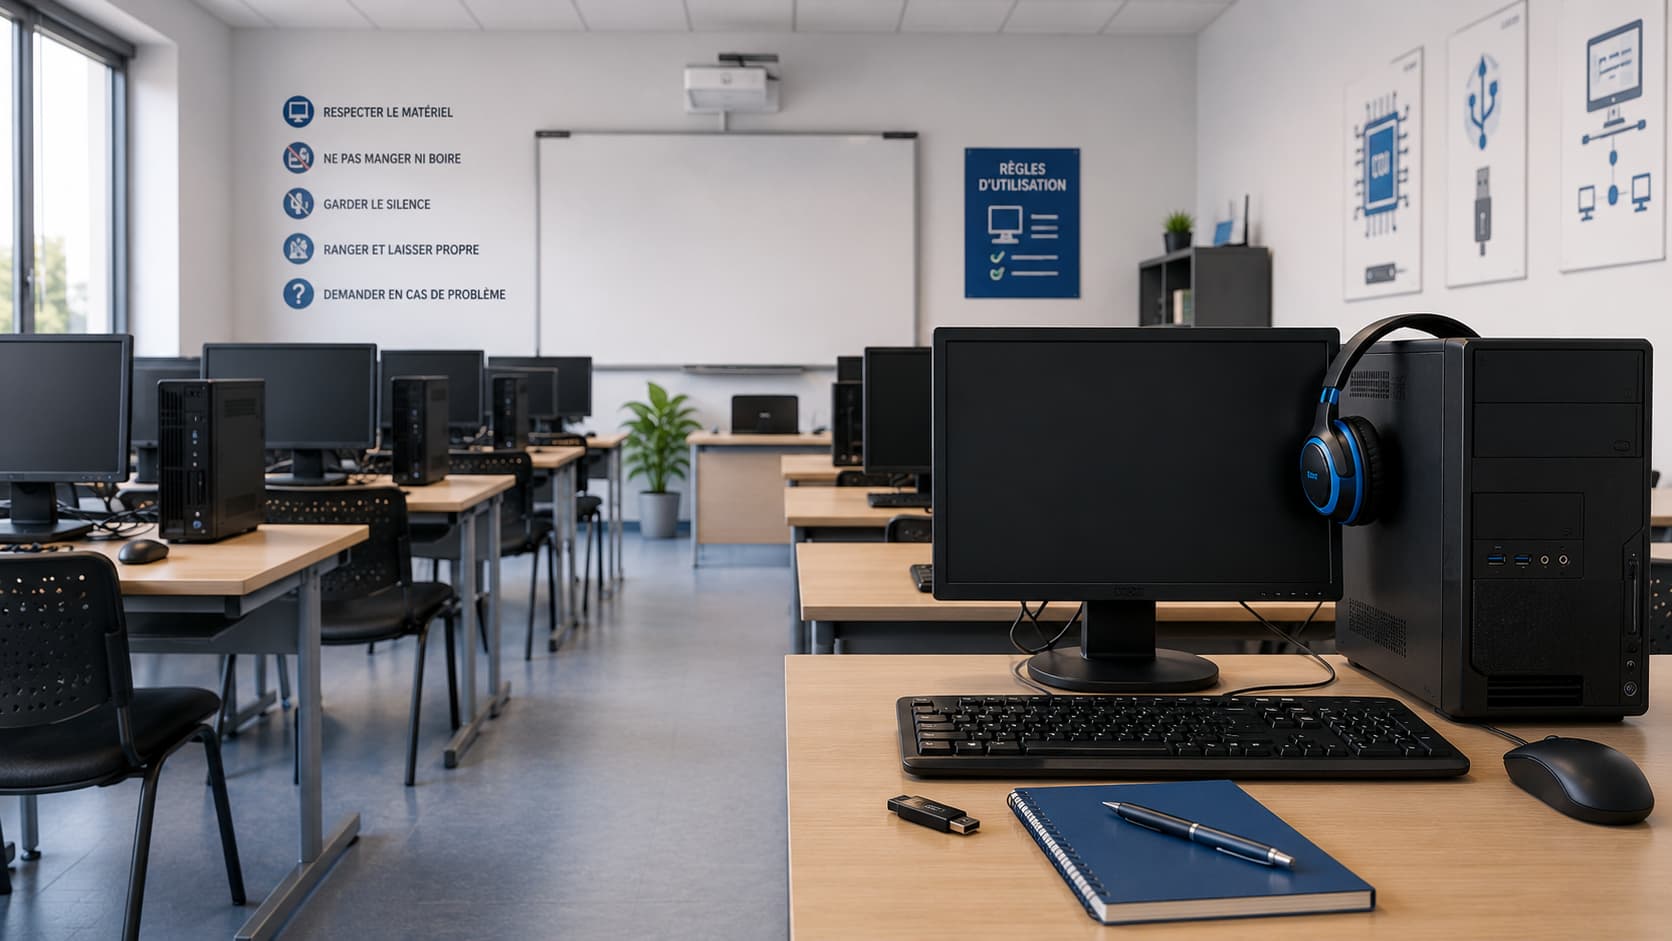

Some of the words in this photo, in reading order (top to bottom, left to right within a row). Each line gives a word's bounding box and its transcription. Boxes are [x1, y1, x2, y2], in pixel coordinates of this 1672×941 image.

[323, 107, 384, 118] RESPECTER
[386, 107, 399, 118] LE
[401, 104, 454, 118] MATÉRIEL
[323, 153, 338, 164] NE
[341, 153, 362, 164] PAS
[364, 153, 412, 164] MANGER
[414, 153, 426, 164] NI
[428, 153, 462, 164] BOIRE
[999, 160, 1046, 175] RÈGLES
[978, 178, 1067, 191] D'UTILISATION
[323, 199, 369, 210] GARDER
[371, 199, 384, 210] LE
[386, 199, 431, 210] SILENCE
[323, 244, 369, 255] RANGER
[371, 244, 385, 255] ET
[388, 244, 433, 255] LAISSER
[435, 244, 480, 255] PROPRE
[323, 289, 386, 300] DEMANDER
[388, 289, 403, 300] EN
[405, 289, 428, 300] CAS
[430, 289, 445, 300] DE
[447, 286, 507, 300] PROBLÈME
